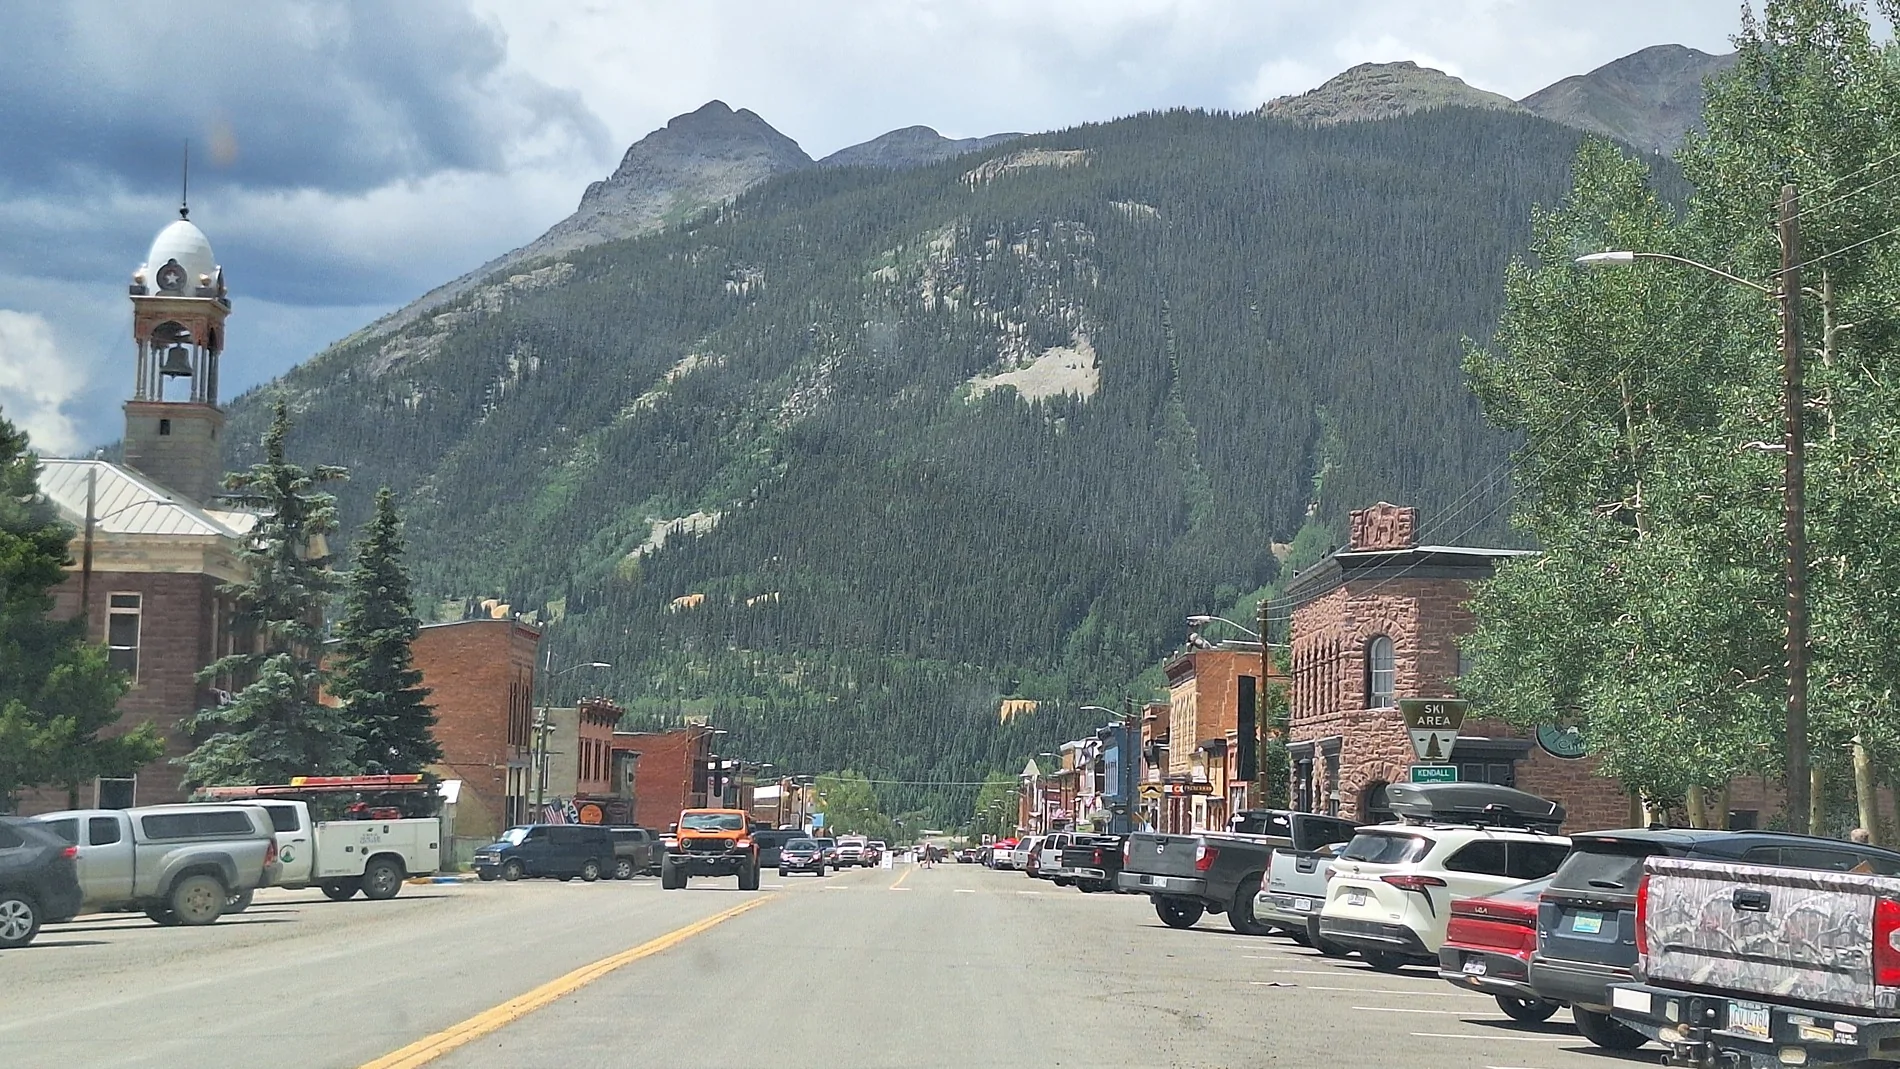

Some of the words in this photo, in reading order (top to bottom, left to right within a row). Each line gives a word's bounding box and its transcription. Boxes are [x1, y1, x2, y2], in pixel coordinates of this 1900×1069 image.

[1424, 704, 1444, 714] SKI
[1417, 716, 1451, 726] AREA
[1417, 769, 1450, 777] KENDALL
